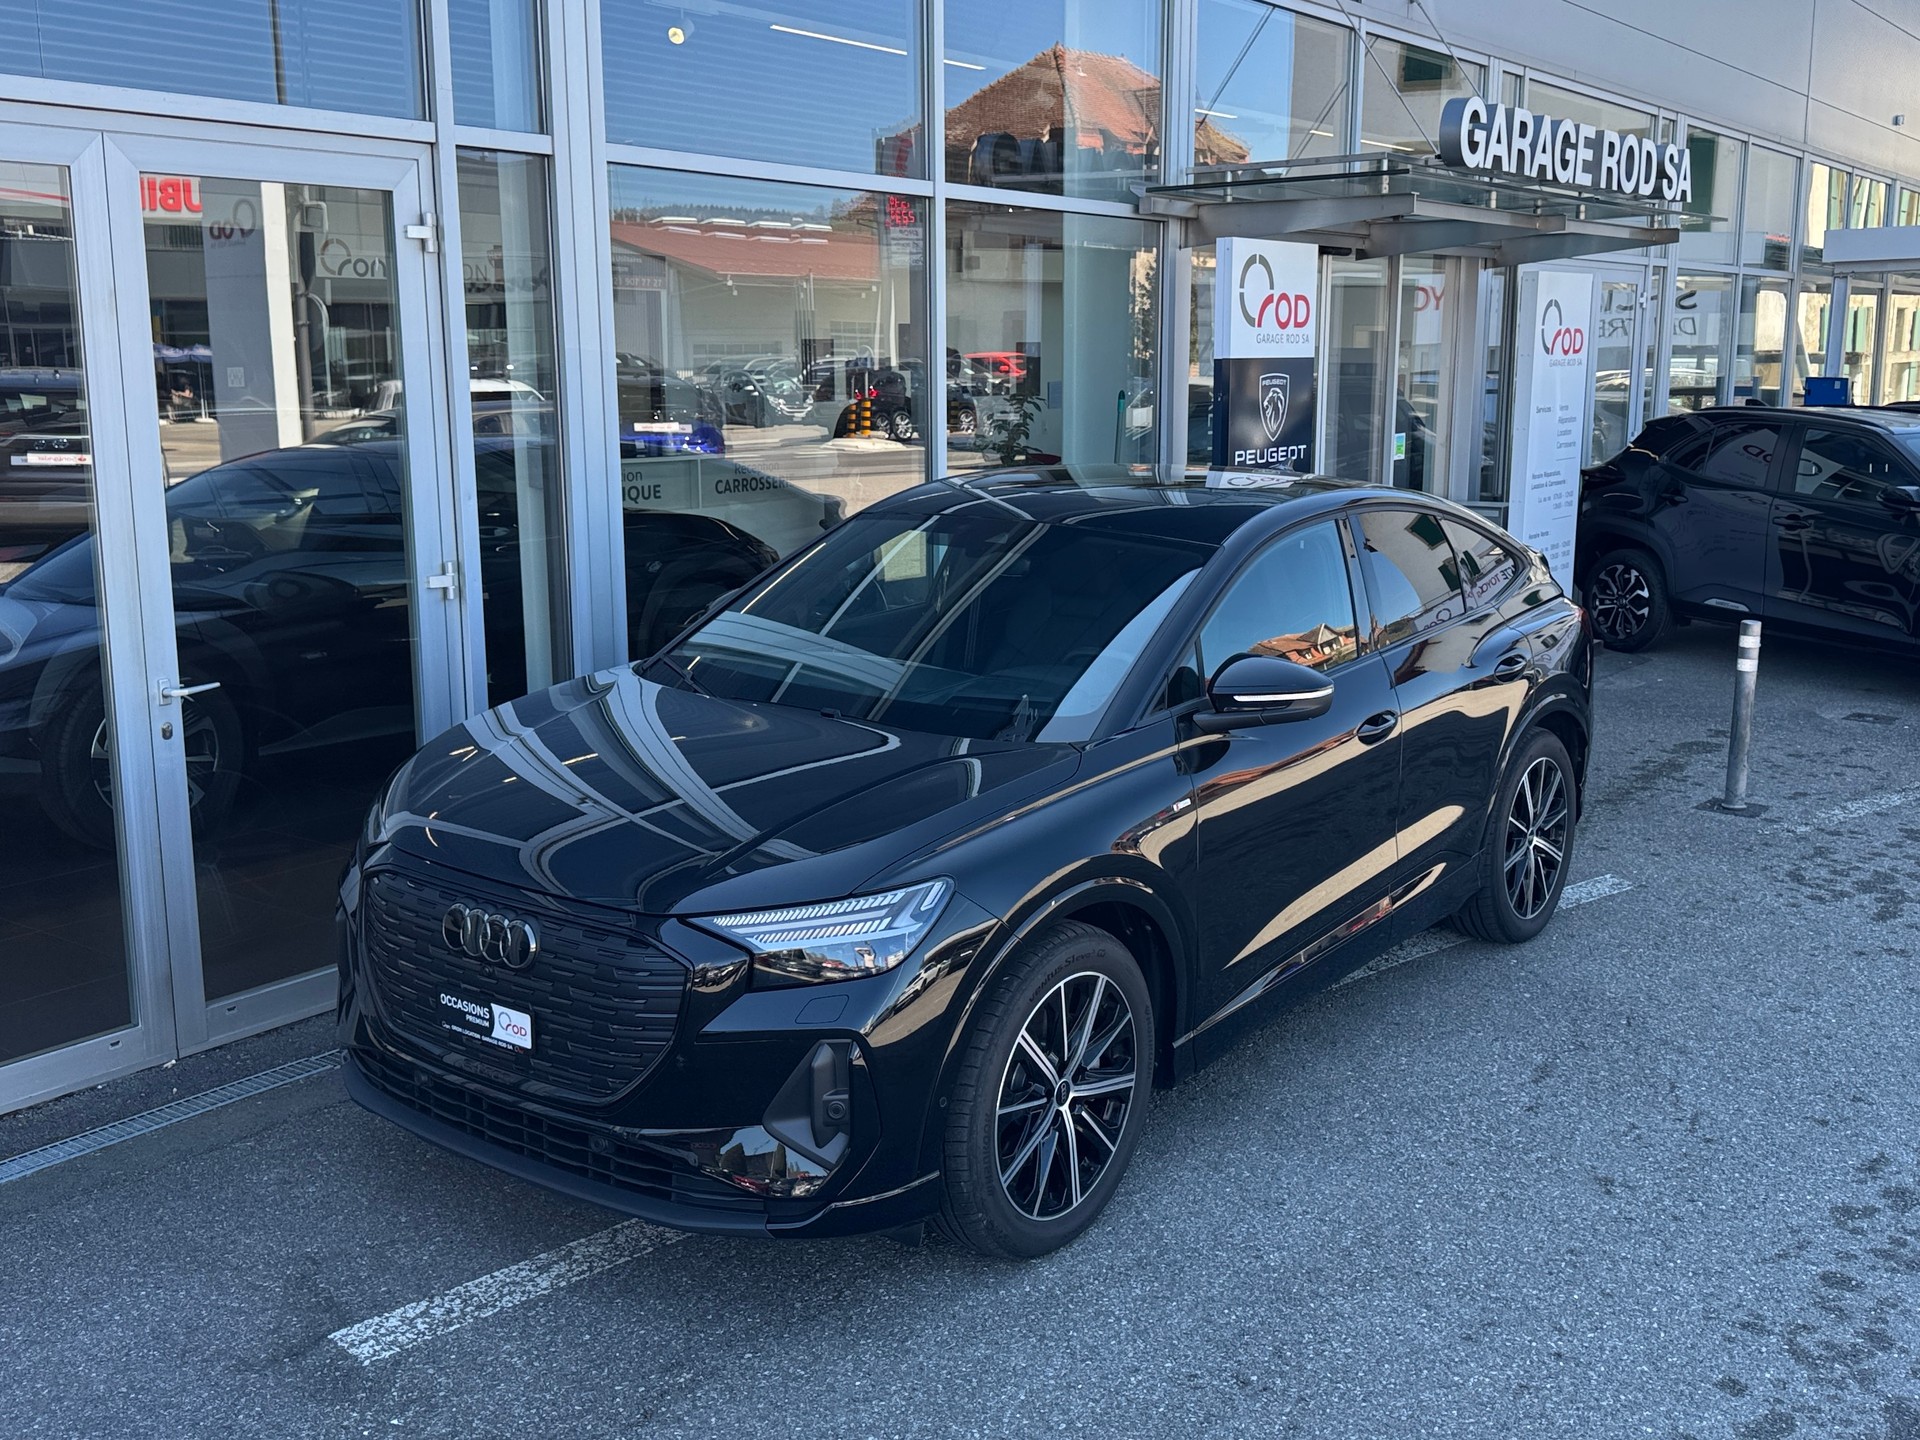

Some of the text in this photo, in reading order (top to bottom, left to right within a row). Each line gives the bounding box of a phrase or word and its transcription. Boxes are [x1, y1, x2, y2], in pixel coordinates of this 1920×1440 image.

[1459, 96, 1692, 203] GARAGE ROD SA
[1256, 333, 1310, 344] GARAGE ROD SA
[1234, 444, 1307, 466] PEUGEOT
[440, 993, 490, 1019] OCCASIONS
[465, 1013, 490, 1028] PREMIUM
